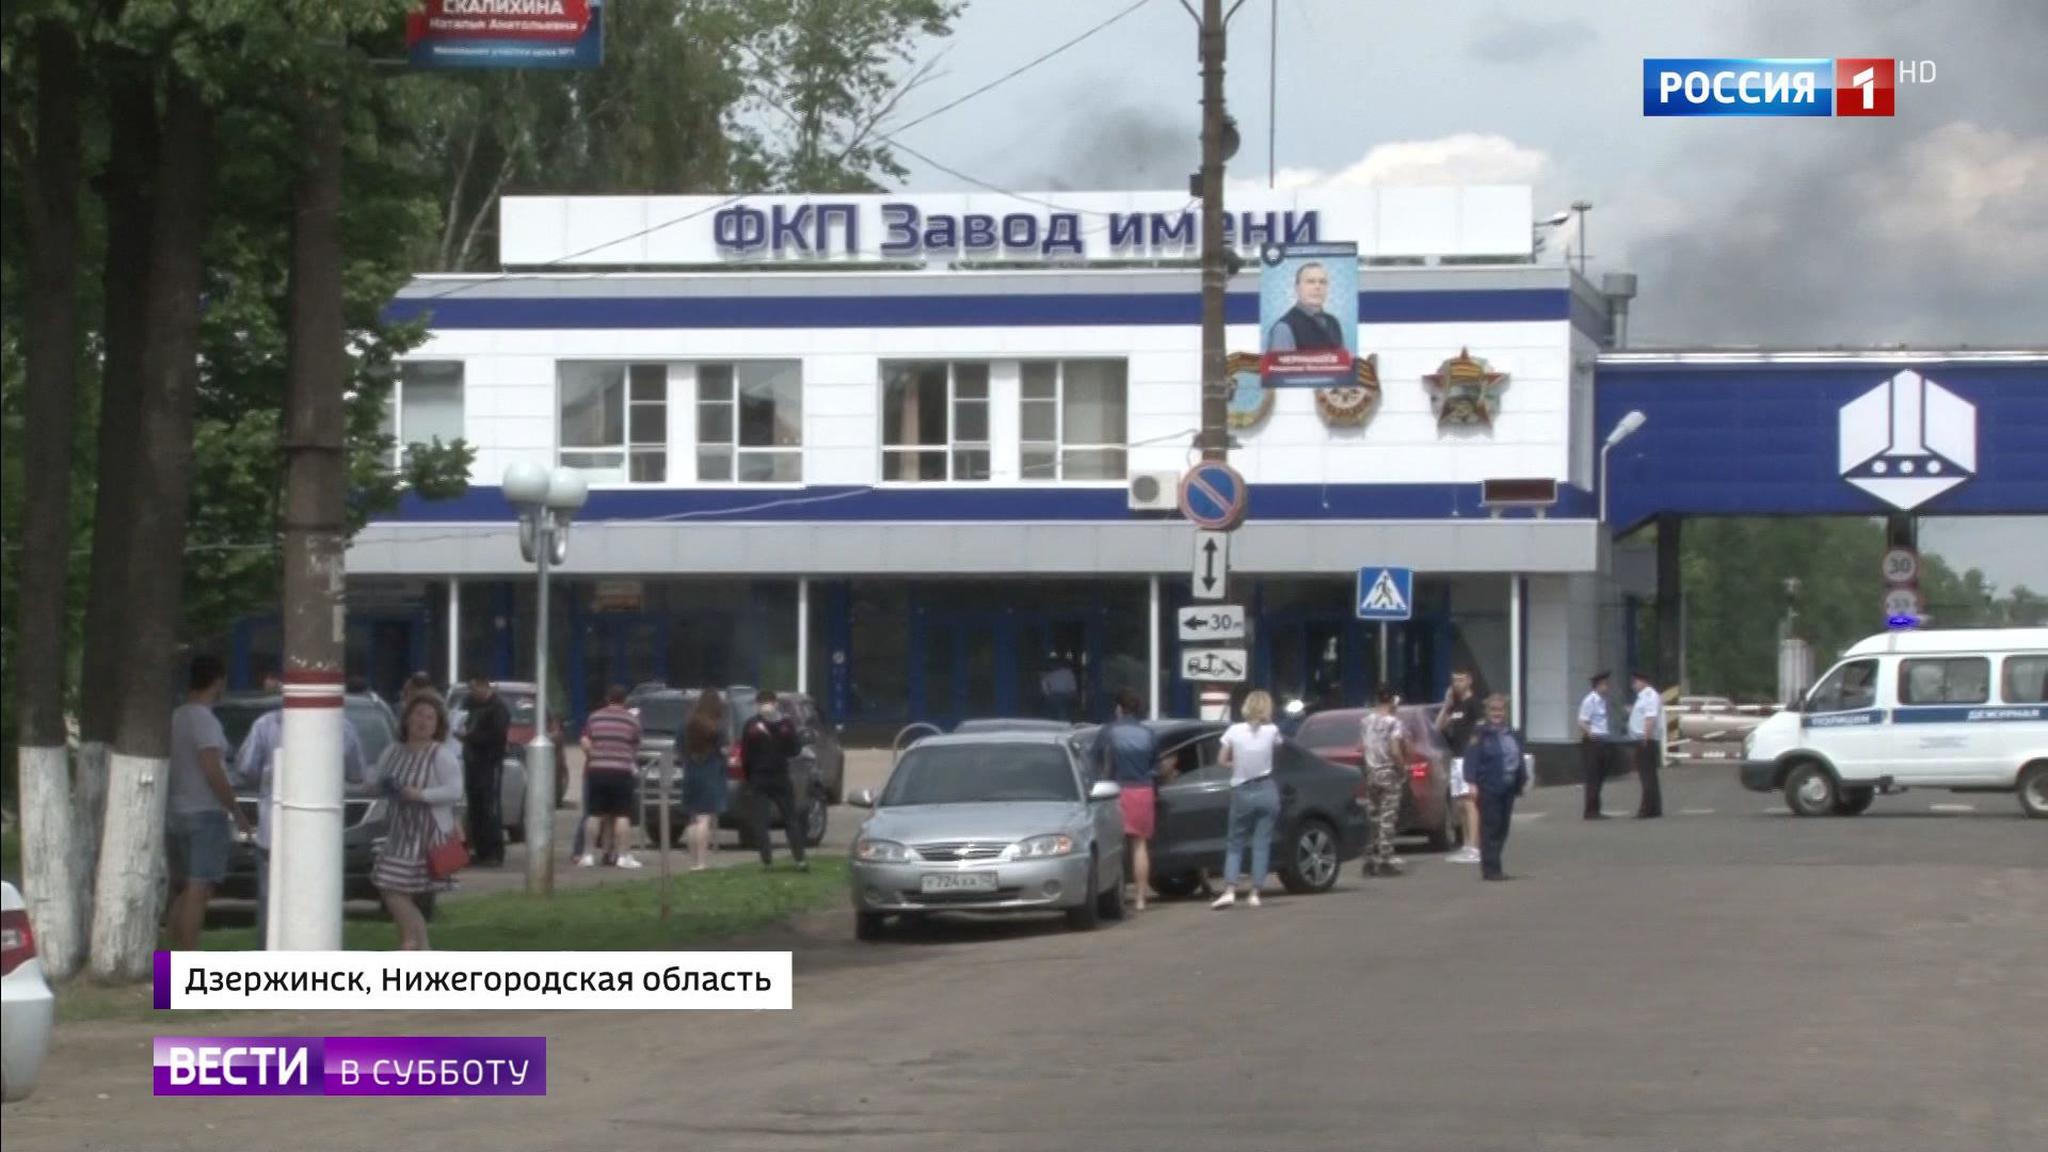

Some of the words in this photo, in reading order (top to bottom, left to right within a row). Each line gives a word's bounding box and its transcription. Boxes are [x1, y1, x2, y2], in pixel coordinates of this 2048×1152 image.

[442, 0, 565, 15] СКАЛИХИНА
[714, 204, 857, 251] ФКП
[880, 203, 1084, 254] Завод
[1888, 558, 1912, 574] 30
[1210, 613, 1232, 632] 30
